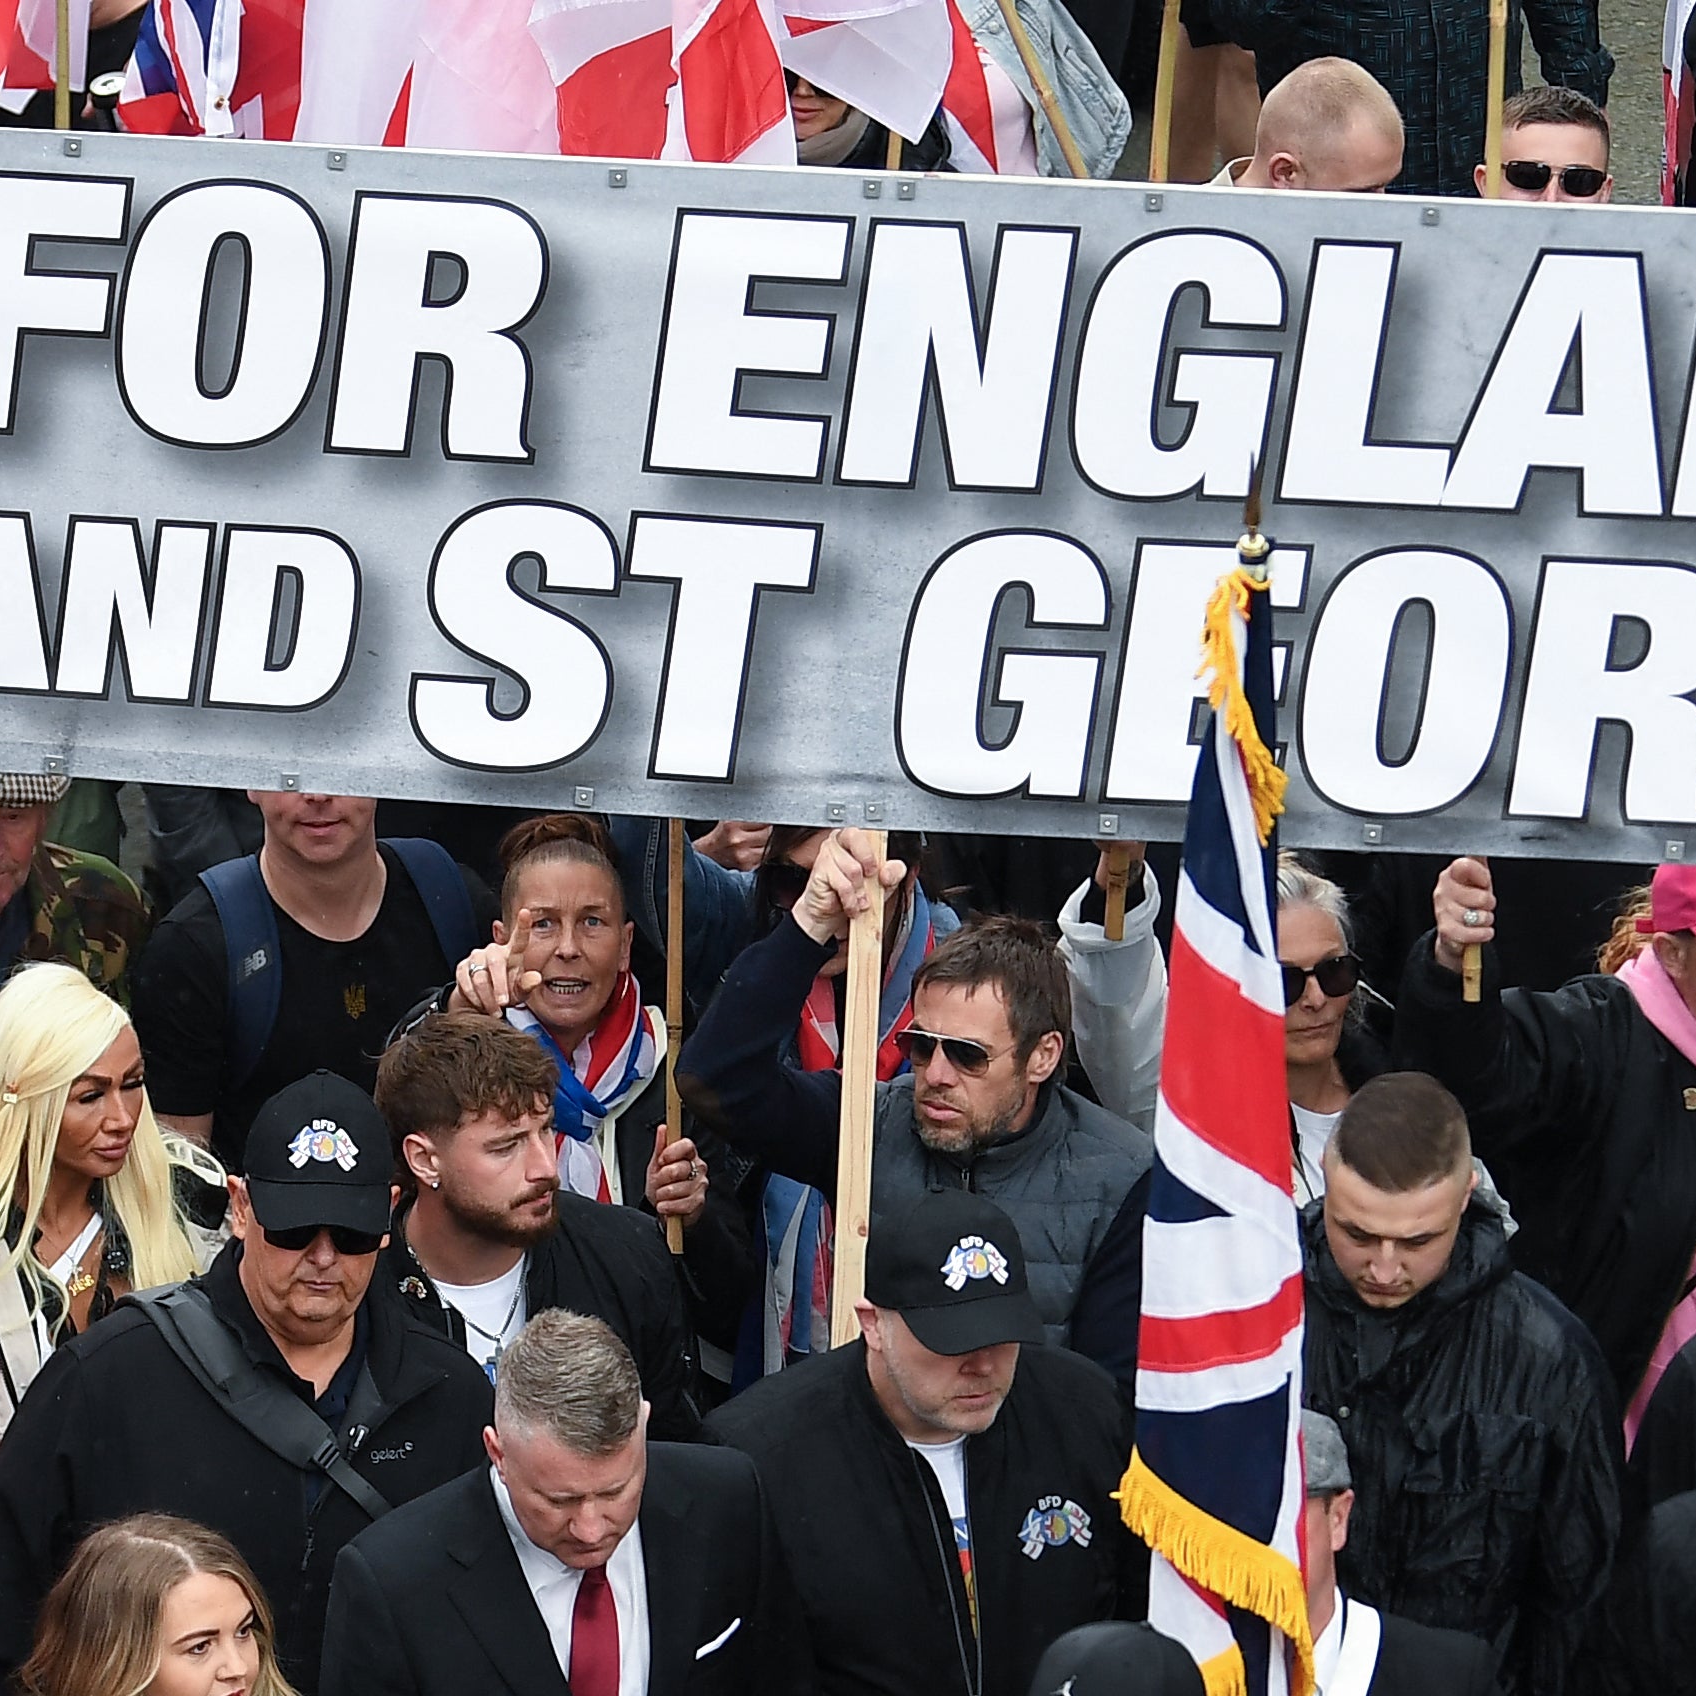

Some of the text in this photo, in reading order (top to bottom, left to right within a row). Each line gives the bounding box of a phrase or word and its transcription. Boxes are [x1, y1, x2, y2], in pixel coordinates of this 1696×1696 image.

[408, 498, 824, 785] ST
[311, 1118, 337, 1132] BFD
[959, 1235, 983, 1249] BFD
[370, 1447, 407, 1464] gelert
[1038, 1496, 1063, 1511] BFD
